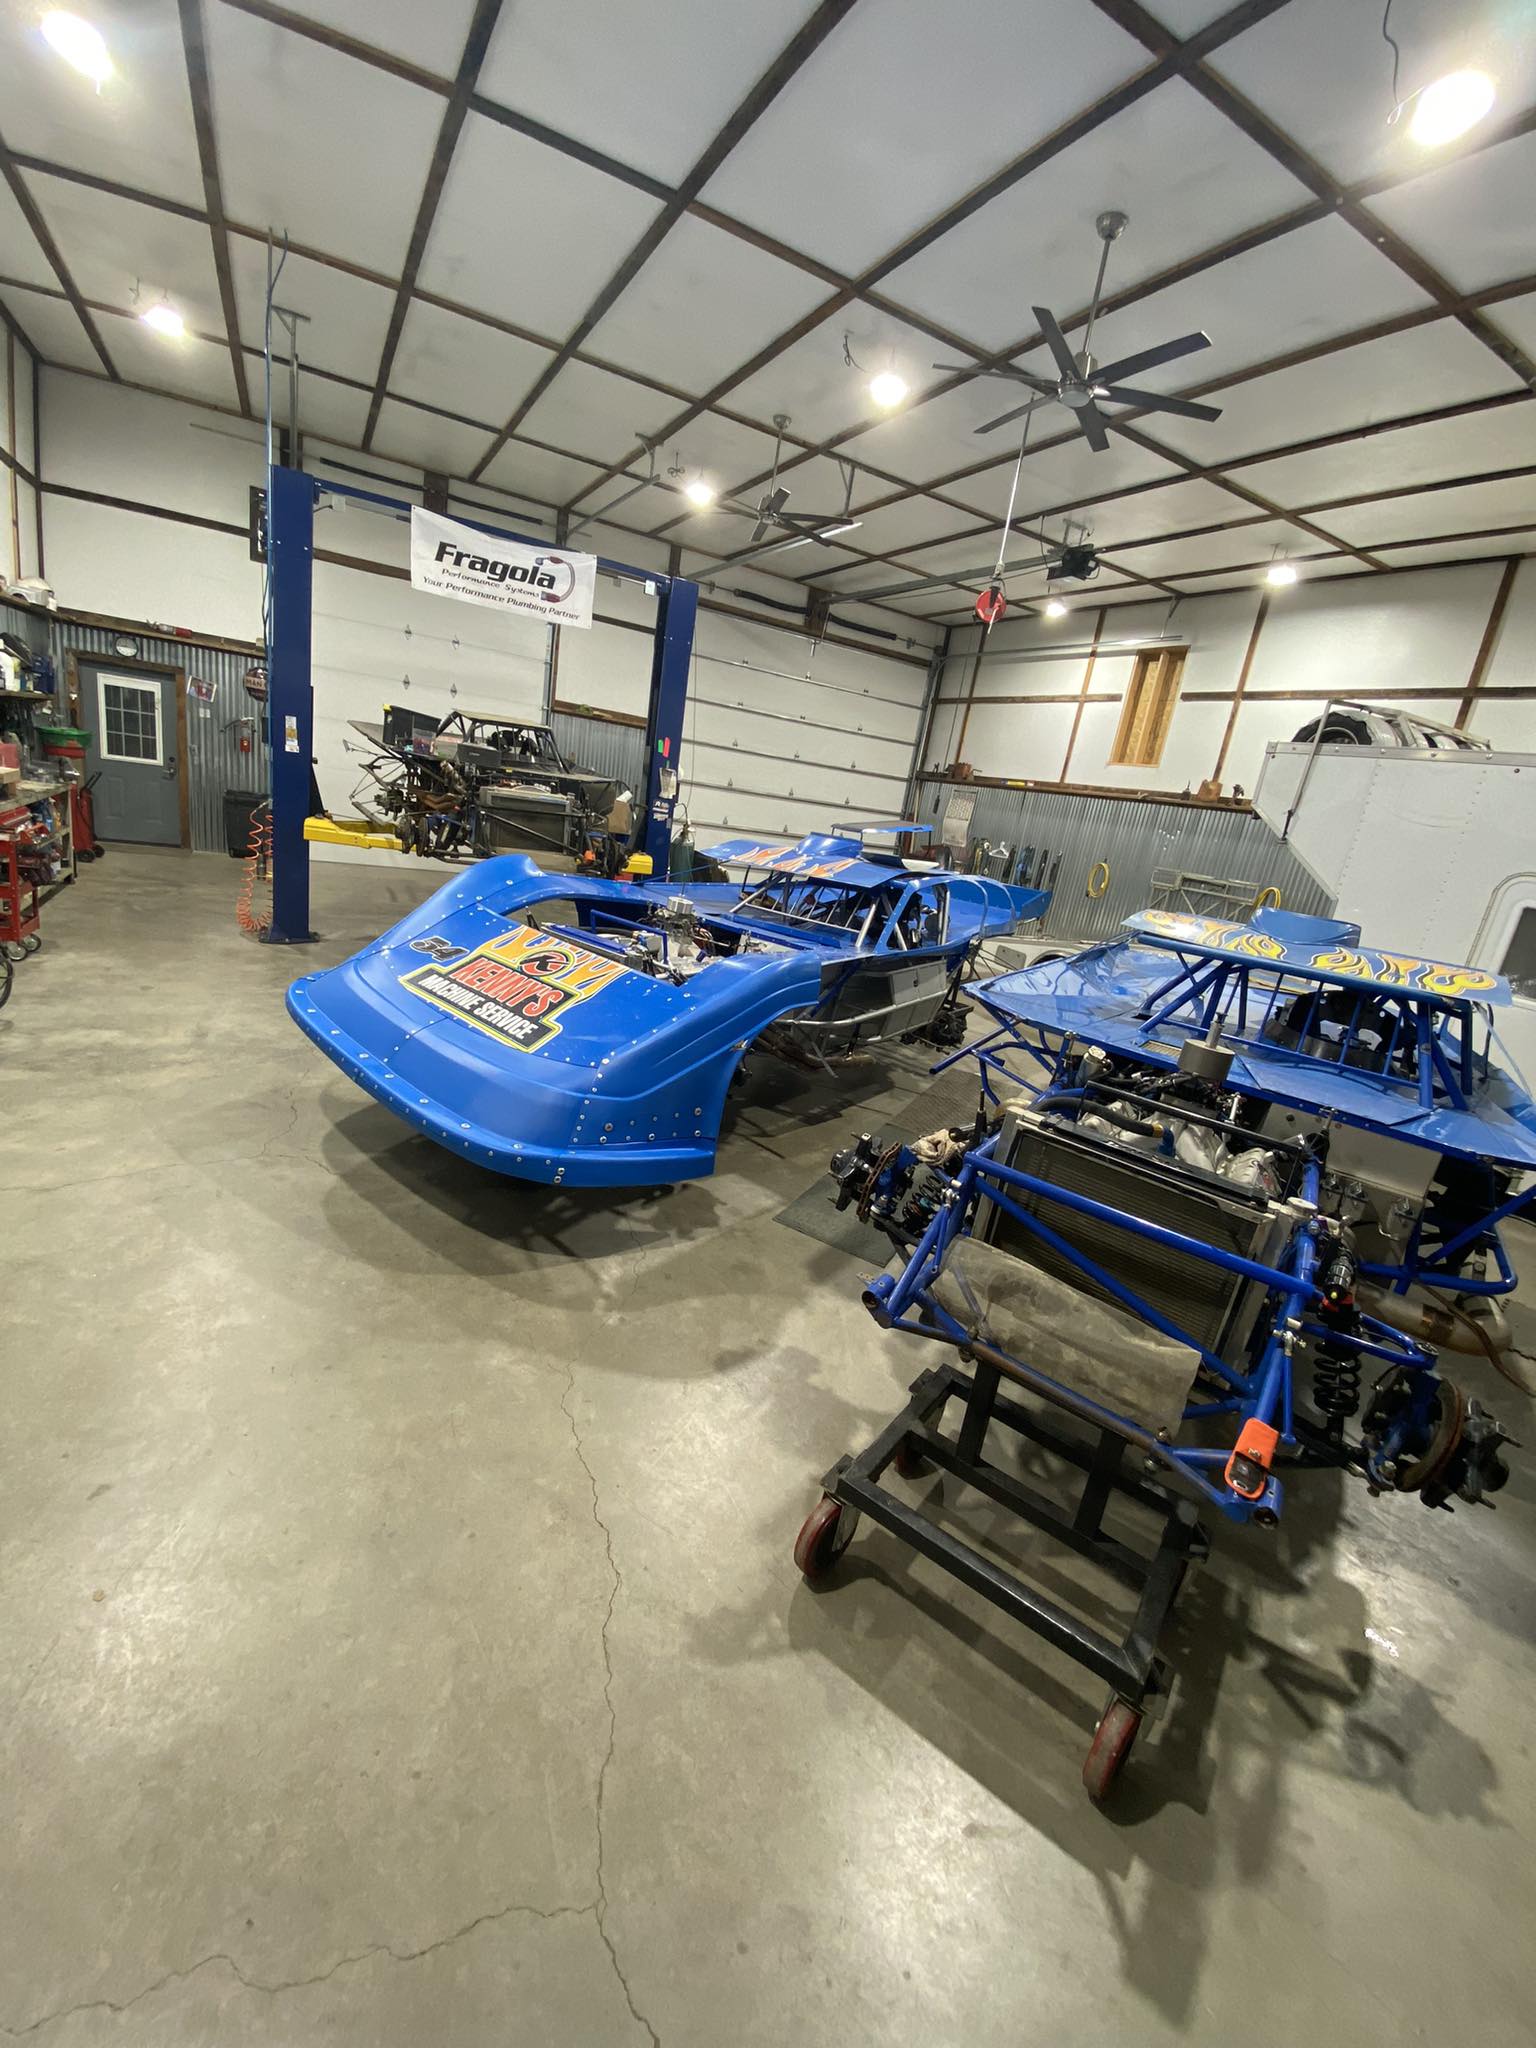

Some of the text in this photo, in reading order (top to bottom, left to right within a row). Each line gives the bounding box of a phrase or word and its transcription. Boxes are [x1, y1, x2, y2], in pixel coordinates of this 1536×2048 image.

[434, 541, 556, 589] Fragola
[441, 568, 540, 599] Performance Systems
[423, 576, 581, 621] Your Performance Plumbing Partner
[418, 974, 539, 1040] MACHINE SERVICE
[451, 958, 564, 1017] KENNY'S
